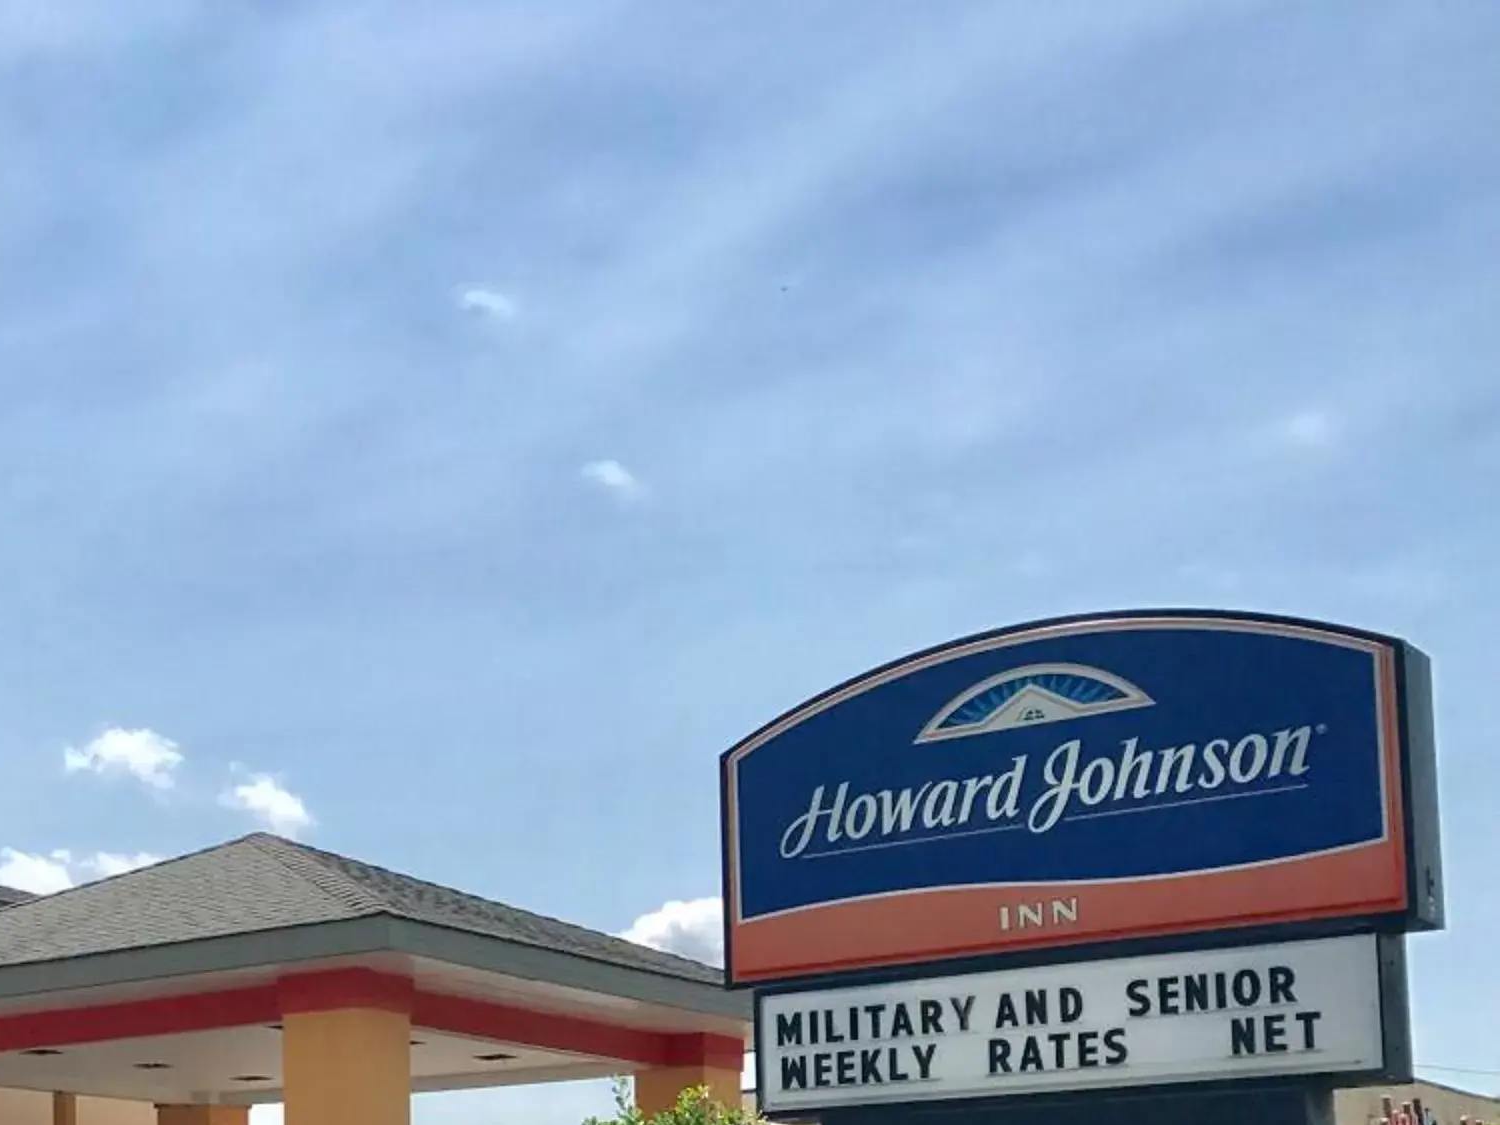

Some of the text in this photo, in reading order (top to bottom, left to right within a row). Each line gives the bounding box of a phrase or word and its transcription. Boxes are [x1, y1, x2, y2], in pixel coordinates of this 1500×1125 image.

[780, 723, 1311, 858] Howard Johnson
[1001, 897, 1078, 930] INN
[777, 966, 1297, 1047] MILITARY AND SENIOR
[781, 1011, 1321, 1090] WEEKLY RATES NET
